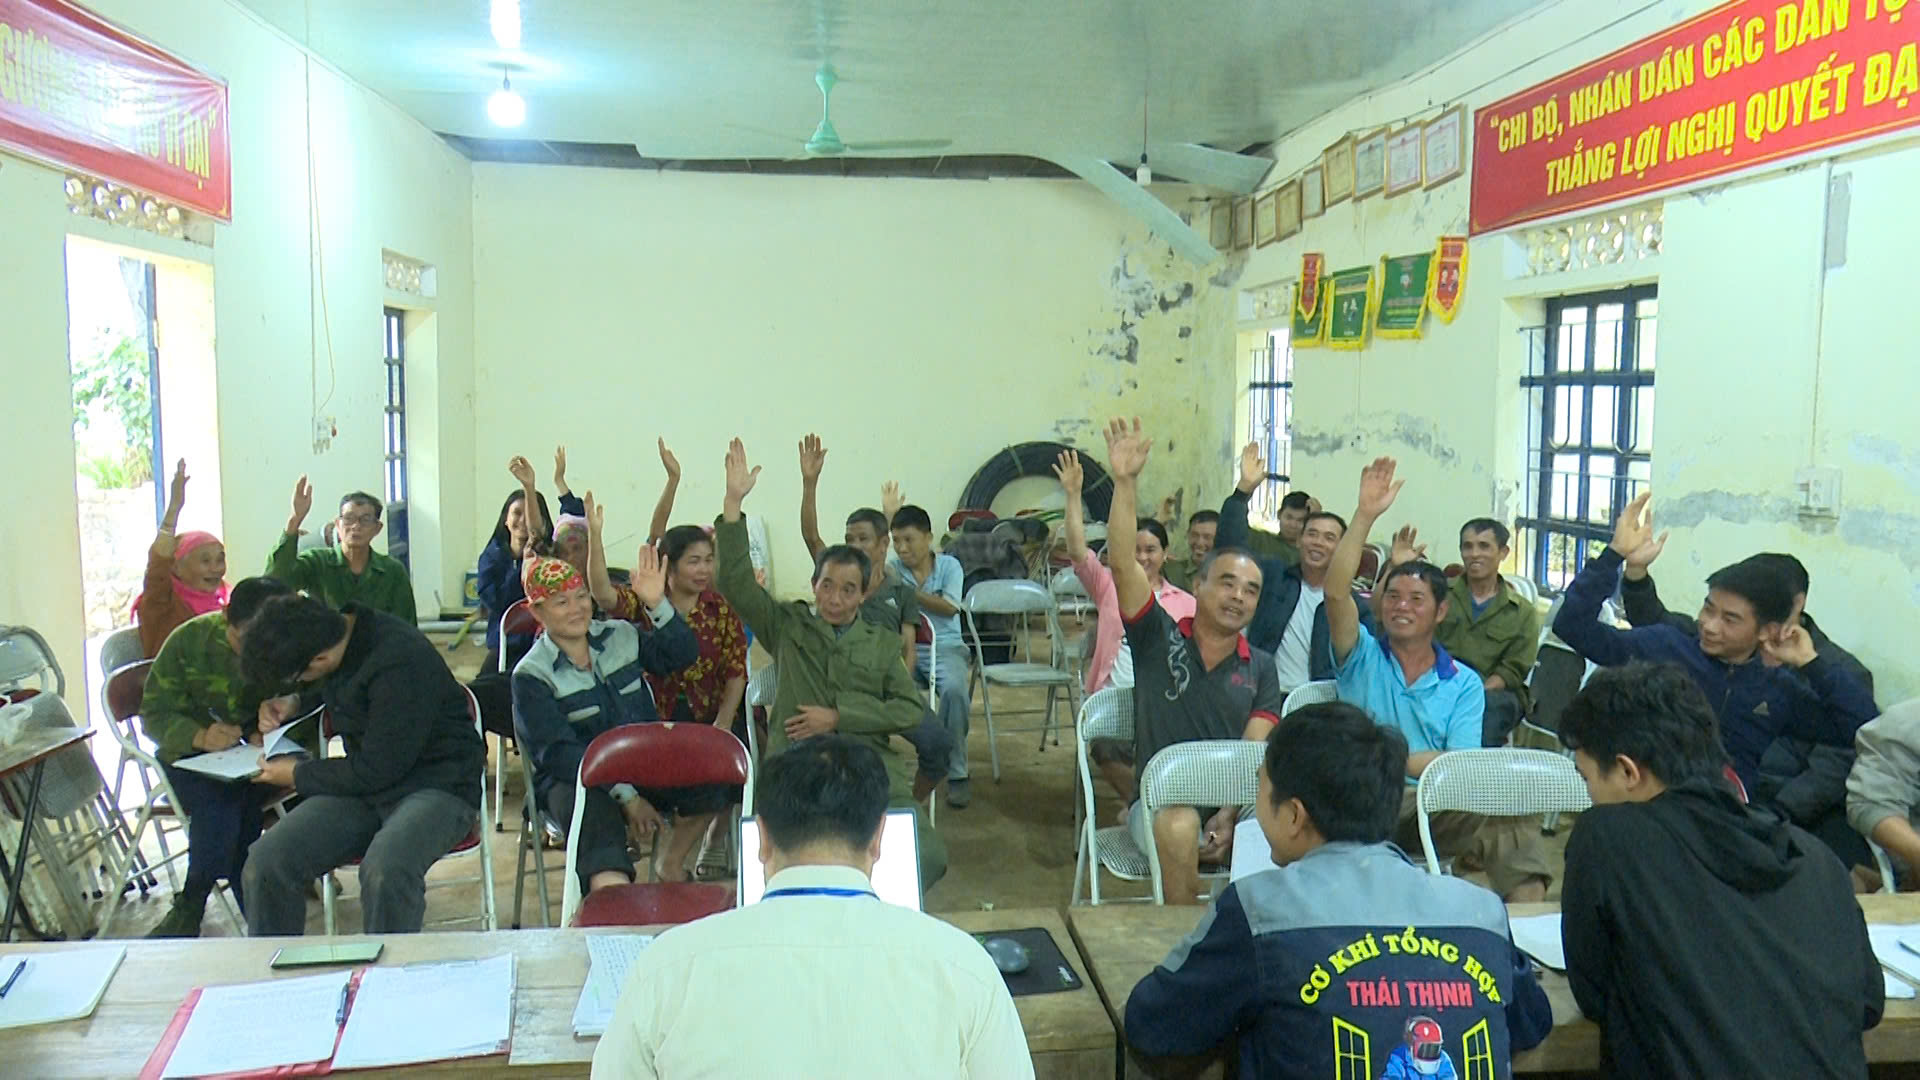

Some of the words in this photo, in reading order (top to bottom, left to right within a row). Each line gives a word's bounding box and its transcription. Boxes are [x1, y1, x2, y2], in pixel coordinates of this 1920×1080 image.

[1532, 93, 1564, 143] BỘ,
[1569, 70, 1632, 127] NHÂN
[1639, 45, 1694, 102] DÂN
[1703, 16, 1765, 79] CÁC
[1546, 137, 1616, 196] THẮNG
[1621, 125, 1662, 179] LỢI
[1666, 101, 1736, 156] NGHỊ
[1745, 51, 1856, 143] QUYẾT
[1300, 963, 1331, 1004] CƠ
[1328, 933, 1380, 975] KHÍ
[1383, 925, 1460, 963] TỔNG
[1346, 976, 1400, 1007] THÁI
[1405, 980, 1474, 1012] THỊNH
